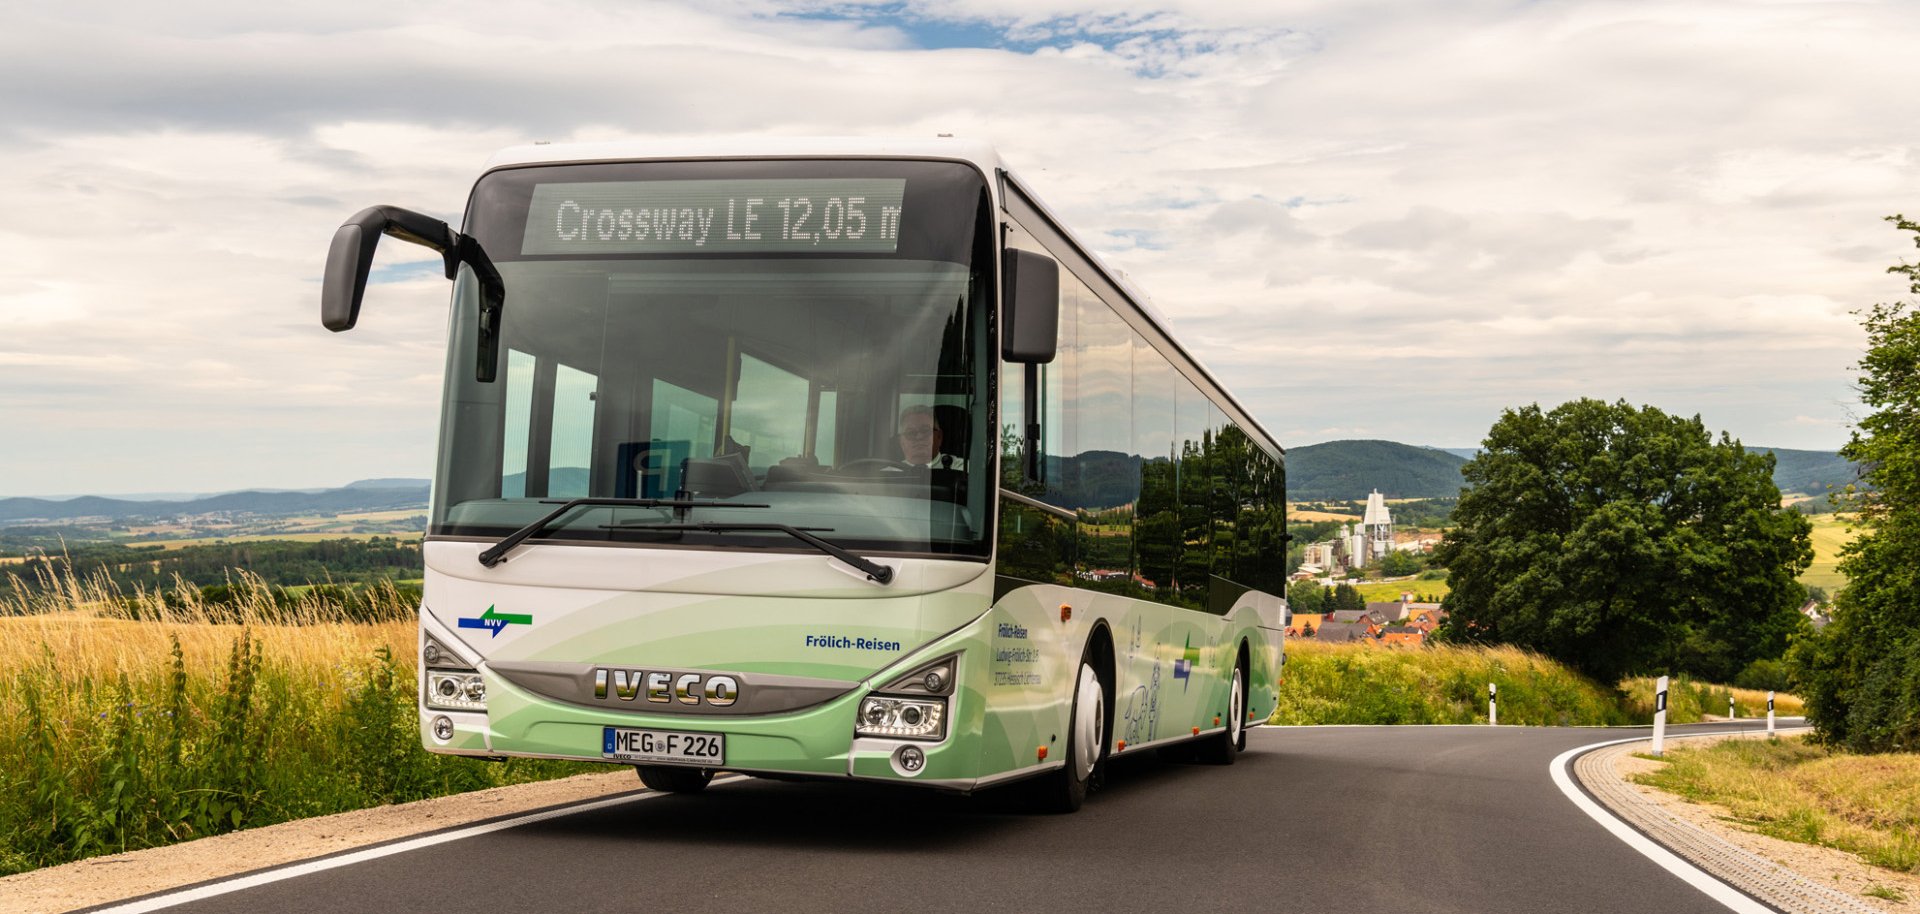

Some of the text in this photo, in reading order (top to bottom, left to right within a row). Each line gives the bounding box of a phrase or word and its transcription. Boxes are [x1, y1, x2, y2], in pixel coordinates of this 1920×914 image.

[556, 199, 715, 247] Crossway
[727, 197, 764, 241] LE
[777, 196, 866, 246] 12,05
[484, 618, 502, 627] NVV
[998, 623, 1028, 639] Frölich-Reisen
[806, 635, 900, 651] Frölich-Reisen
[594, 668, 739, 707] IVECO
[616, 731, 719, 757] MEG F 226
